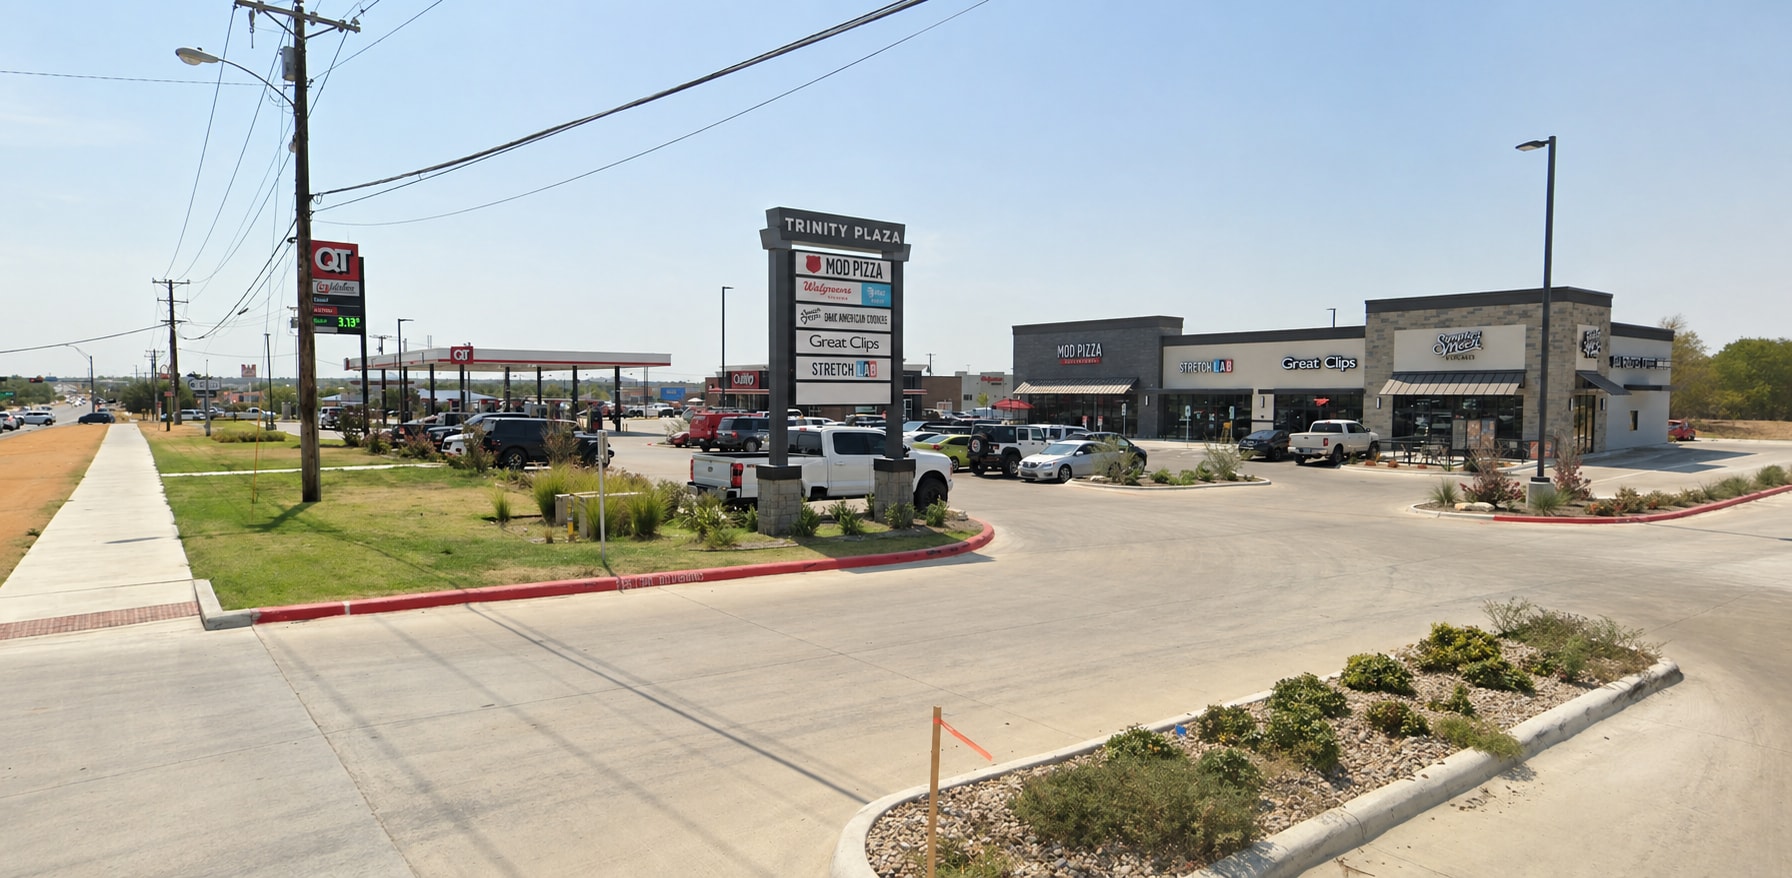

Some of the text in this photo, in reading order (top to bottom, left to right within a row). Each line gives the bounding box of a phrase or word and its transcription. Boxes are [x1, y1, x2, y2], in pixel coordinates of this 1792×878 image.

[785, 216, 901, 244] TRINITY PLAZA
[315, 247, 352, 273] QT
[826, 257, 883, 280] MOD PIZZA
[809, 334, 880, 352] Great Clips
[1057, 343, 1102, 358] MOD PIZZA
[453, 349, 470, 360] QT
[1281, 356, 1356, 372] Great Clips
